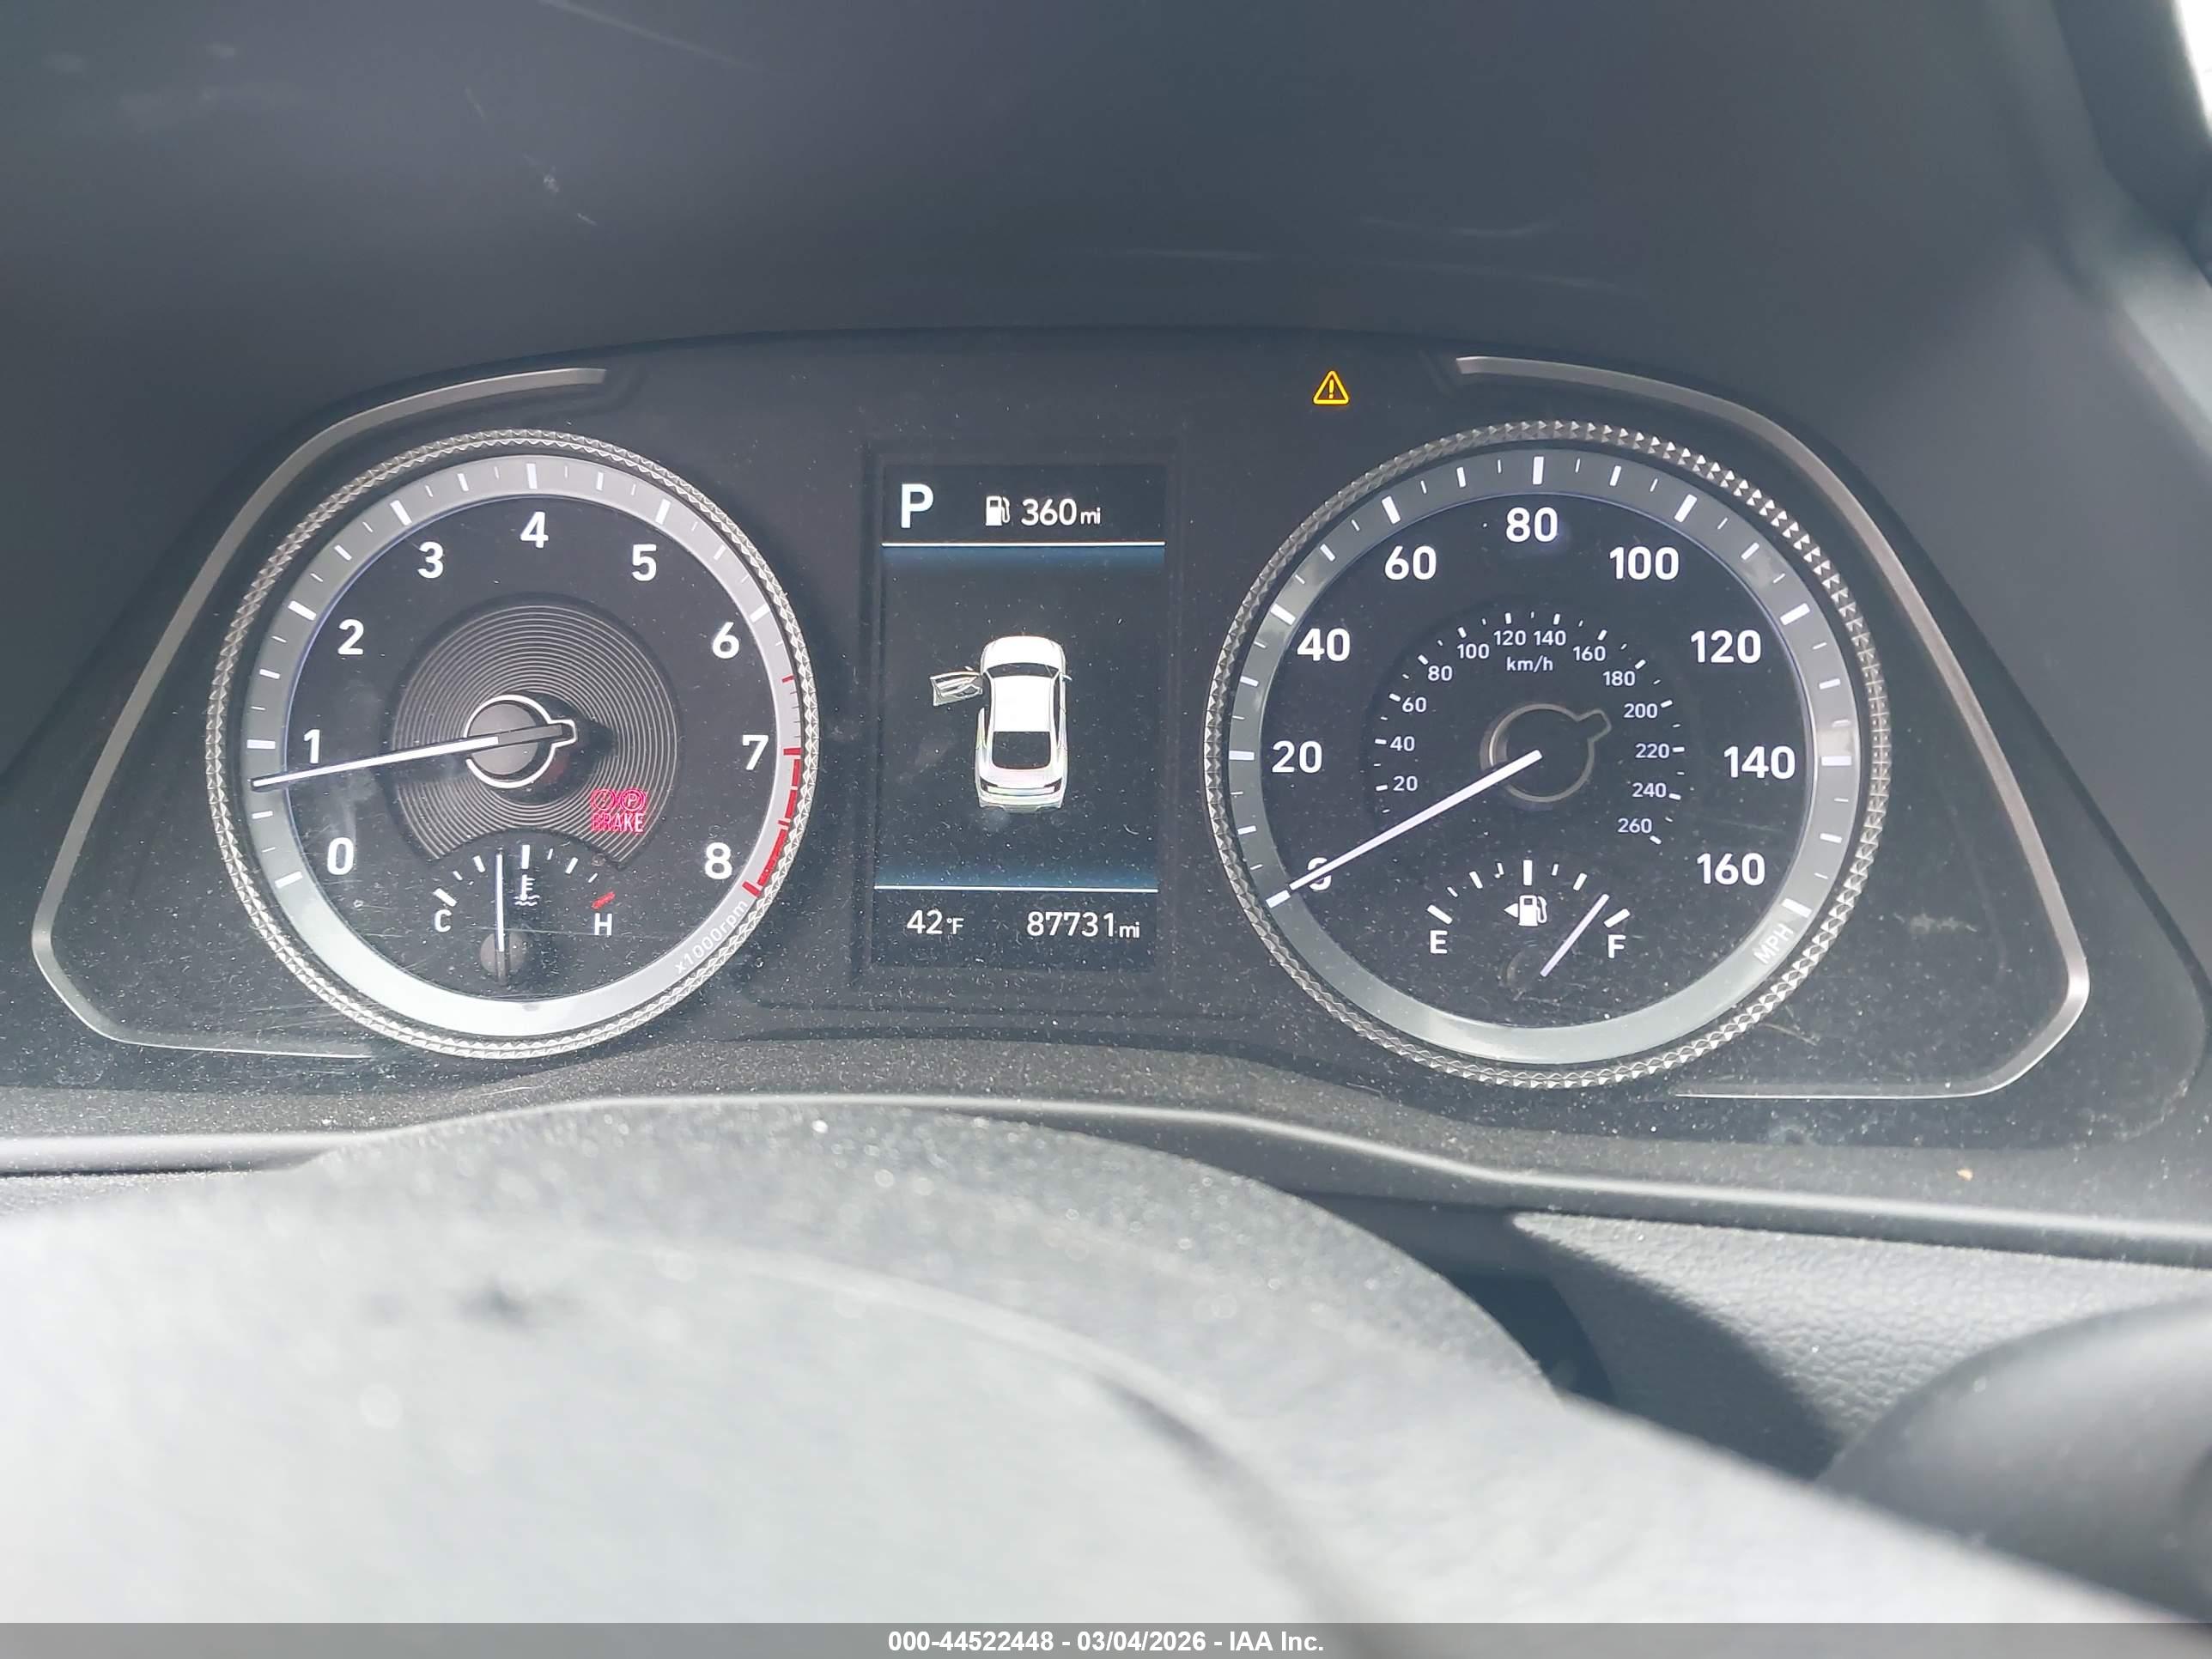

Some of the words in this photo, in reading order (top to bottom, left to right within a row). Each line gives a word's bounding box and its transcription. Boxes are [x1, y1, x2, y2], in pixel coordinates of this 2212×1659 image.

[901, 483, 934, 529] P
[520, 511, 549, 549] 4
[1505, 507, 1559, 543] 80
[417, 543, 445, 580] 3
[631, 544, 657, 581] 5
[1384, 545, 1437, 580] 60
[1609, 546, 1680, 580] 100
[337, 618, 364, 655] 2
[711, 621, 740, 659] 6
[1297, 628, 1351, 662] 40
[1456, 643, 1490, 659] 100
[1493, 629, 1527, 646] 120
[1533, 629, 1566, 646] 140
[1691, 629, 1761, 664] 120
[1506, 654, 1553, 673] km/h
[1572, 645, 1606, 661] 160
[1427, 665, 1453, 682] 80
[1602, 670, 1636, 686] 180
[1401, 696, 1427, 713] 60
[1623, 702, 1658, 719] 200
[303, 729, 322, 763] 1
[742, 734, 769, 770] 7
[1272, 740, 1322, 774] 20
[1389, 736, 1415, 751] 40
[1635, 743, 1670, 759] 220
[1723, 745, 1796, 780] 140
[1393, 775, 1418, 792] 20
[1632, 782, 1667, 798] 240
[591, 811, 644, 833] BRAKE
[1617, 817, 1652, 834] 260
[326, 836, 355, 876] 0
[705, 842, 732, 878] 8
[1697, 852, 1765, 886] 160
[434, 908, 453, 933] C
[593, 912, 613, 935] H
[1430, 929, 1448, 954] E
[1607, 934, 1626, 959] F
[1753, 922, 1794, 964] MPH
